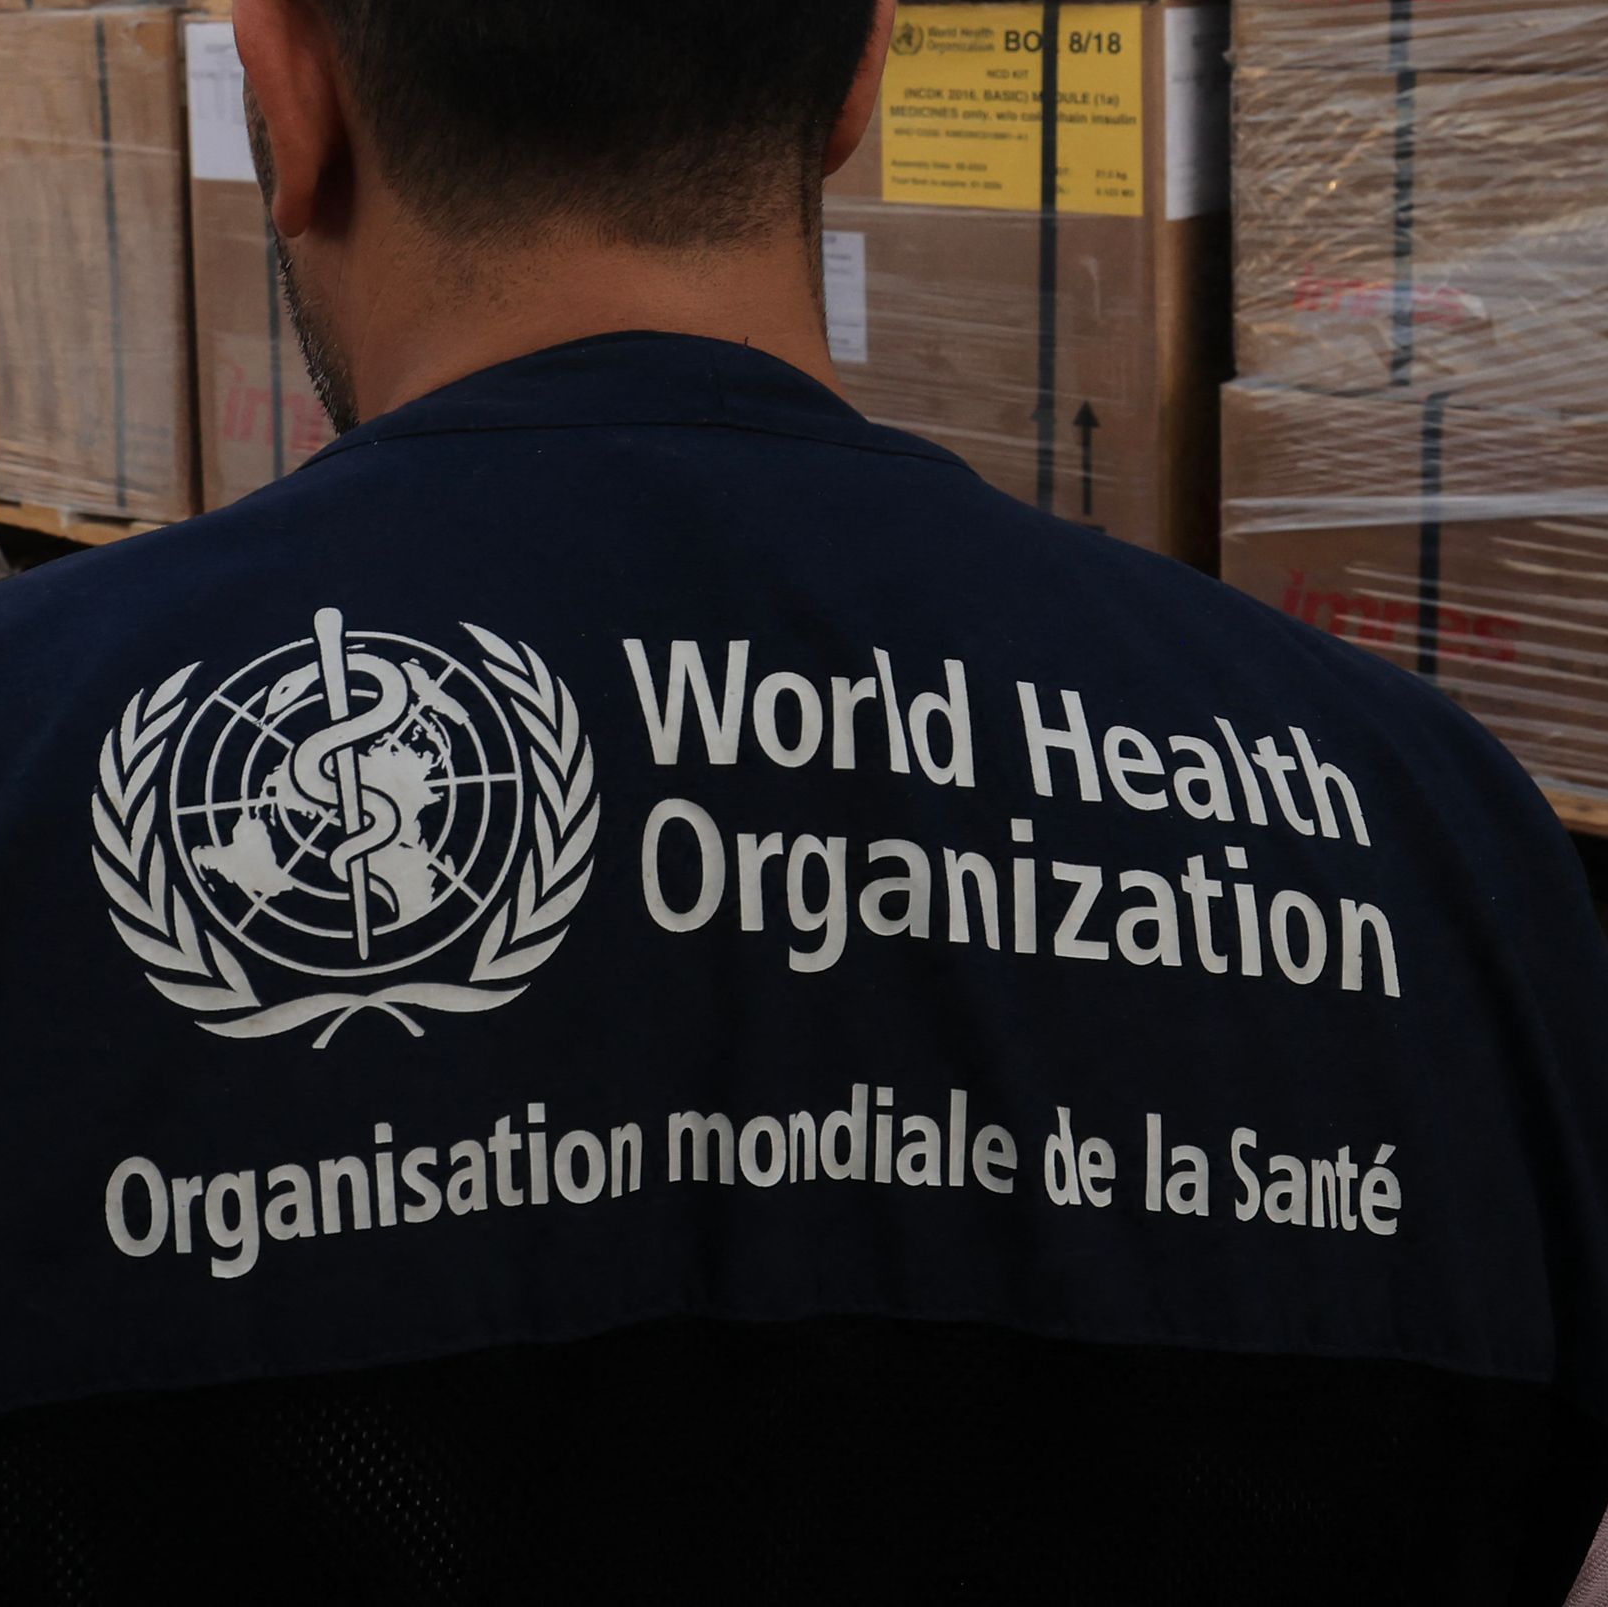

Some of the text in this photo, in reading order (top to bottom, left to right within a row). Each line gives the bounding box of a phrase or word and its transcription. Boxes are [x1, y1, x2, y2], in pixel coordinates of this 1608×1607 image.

[1004, 30, 1122, 55] BO 8/18
[890, 105, 959, 120] MEDICINES
[1091, 112, 1137, 126] insulin
[1283, 570, 1520, 663] imres
[623, 637, 1373, 847] World Health
[639, 796, 1402, 999] Organization
[104, 1083, 1404, 1280] Organisation mondiale de la Santé
